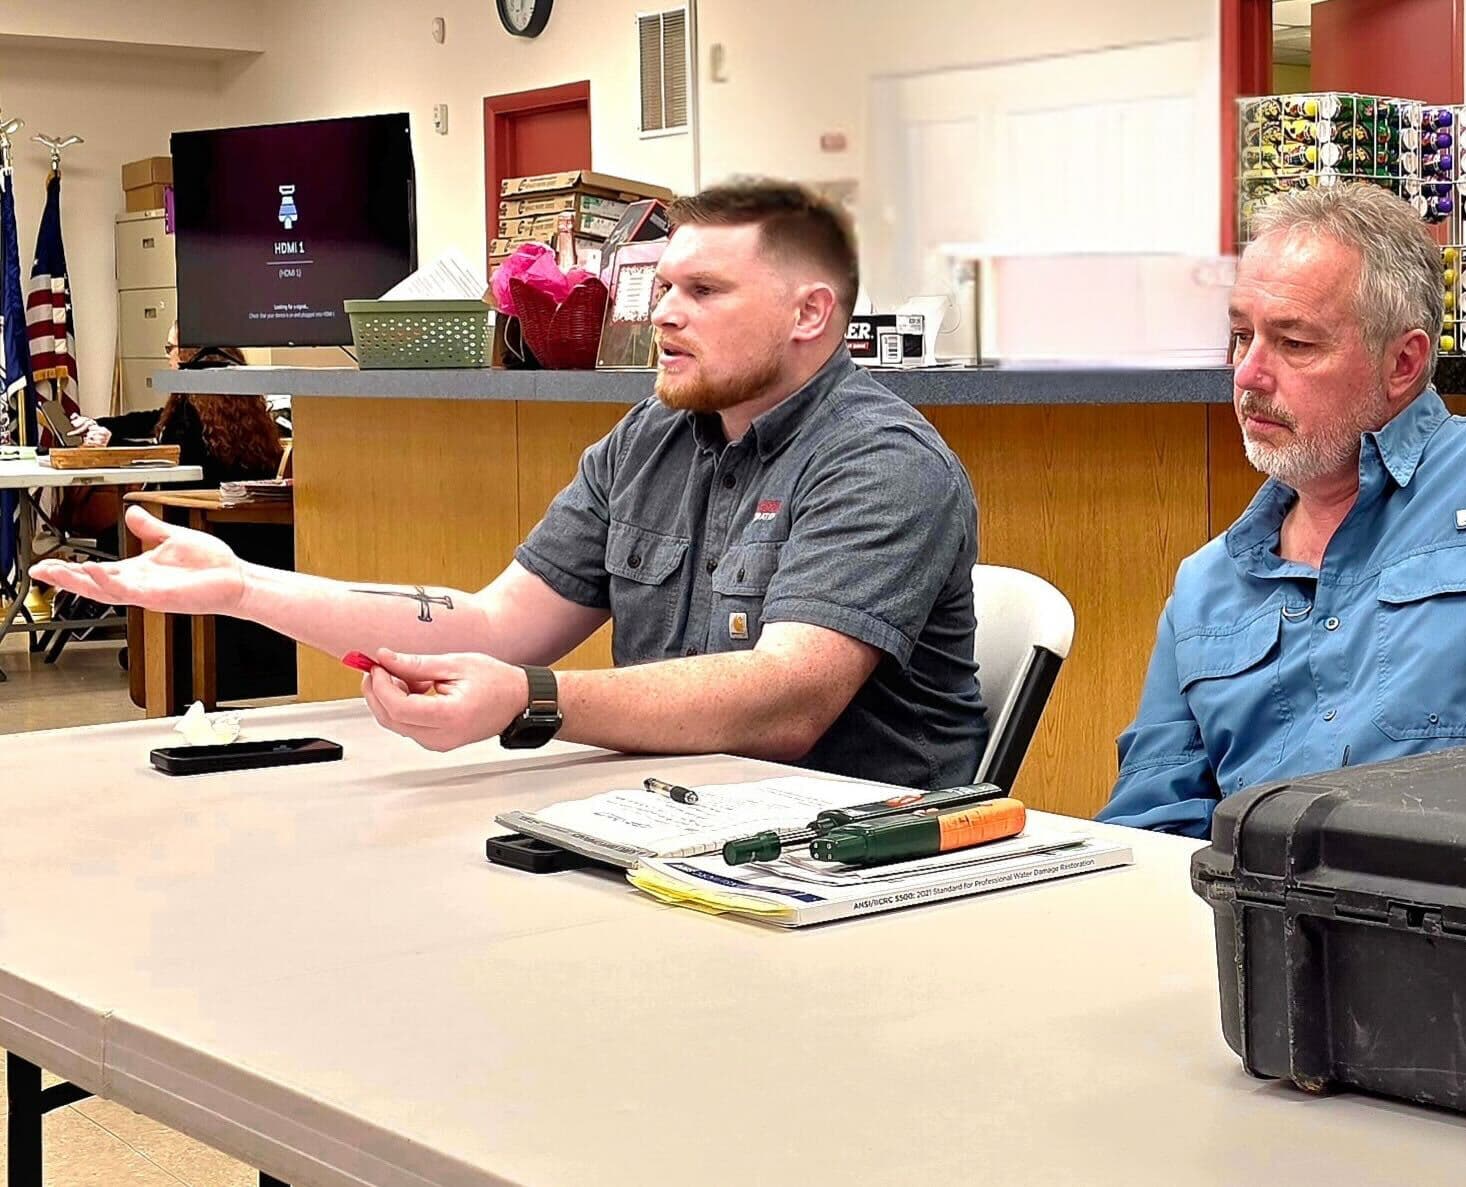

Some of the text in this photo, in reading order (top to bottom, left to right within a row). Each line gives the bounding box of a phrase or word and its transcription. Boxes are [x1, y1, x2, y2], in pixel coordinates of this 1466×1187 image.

[274, 241, 305, 255] HDMI 1
[850, 322, 874, 340] ER.
[895, 892, 915, 903] S500:
[916, 889, 932, 899] 2021
[933, 883, 962, 895] Standard
[963, 881, 973, 889] for
[974, 873, 1013, 886] Professional
[1013, 871, 1032, 880] Water
[1033, 865, 1059, 876] Damage
[1060, 859, 1096, 871] Restoration
